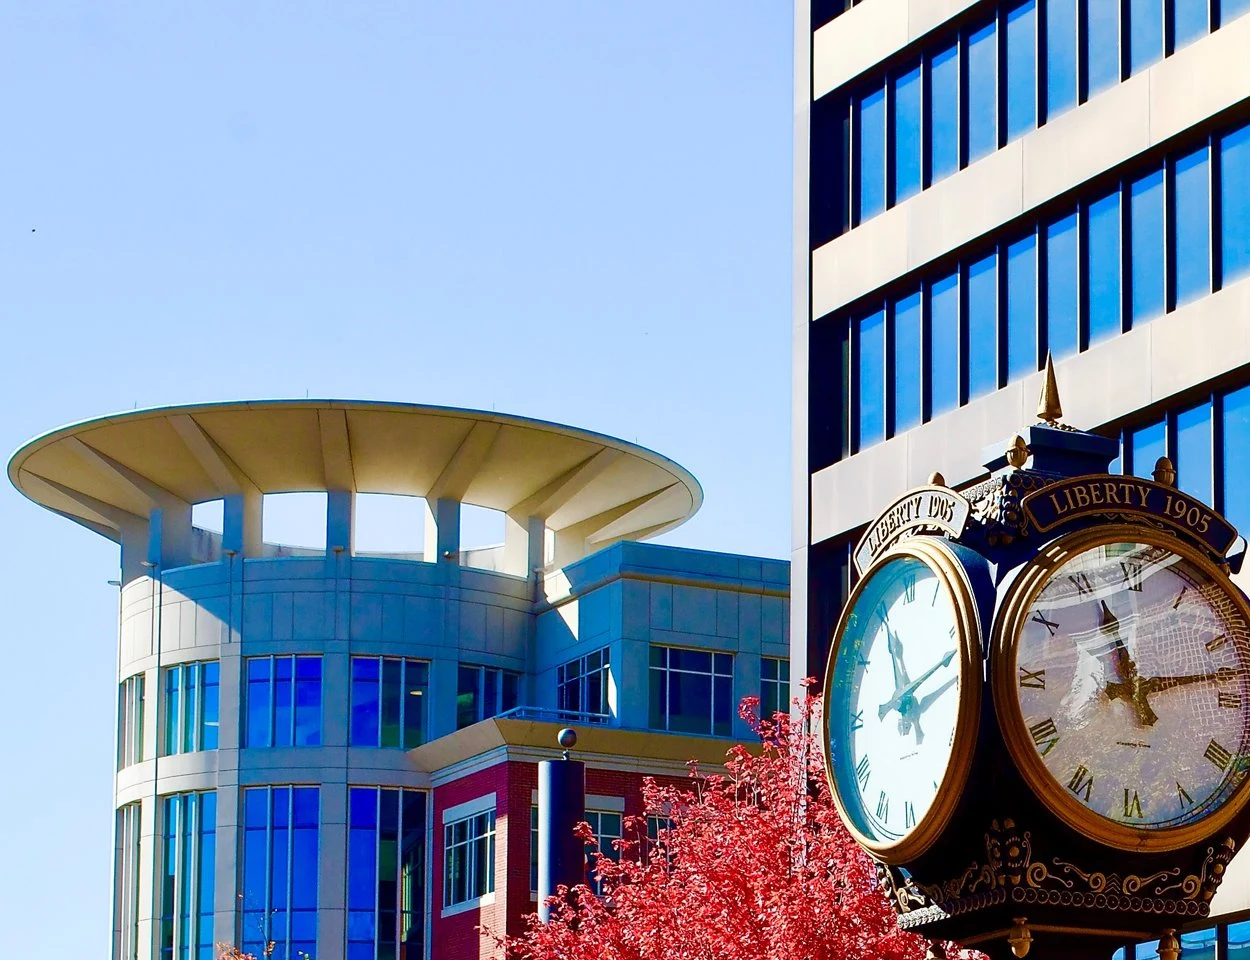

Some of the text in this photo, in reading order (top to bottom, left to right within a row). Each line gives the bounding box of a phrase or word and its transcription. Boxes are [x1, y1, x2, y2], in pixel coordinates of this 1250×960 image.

[1049, 483, 1213, 534] LIBERTY 1905
[867, 493, 955, 557] LIBERTY 1905
[903, 573, 916, 606] XII
[1068, 573, 1094, 595] XI
[1120, 562, 1143, 593] XII
[1031, 609, 1060, 637] X
[1205, 633, 1228, 653] II
[1019, 666, 1046, 690] IX
[1218, 691, 1242, 709] III
[851, 709, 864, 732] IX
[1029, 717, 1060, 759] VIII
[1203, 738, 1233, 772] IIII
[1067, 764, 1094, 802] VII
[1176, 781, 1195, 809] V
[876, 790, 889, 824] VII
[904, 801, 917, 829] VI
[1123, 788, 1144, 819] VI
